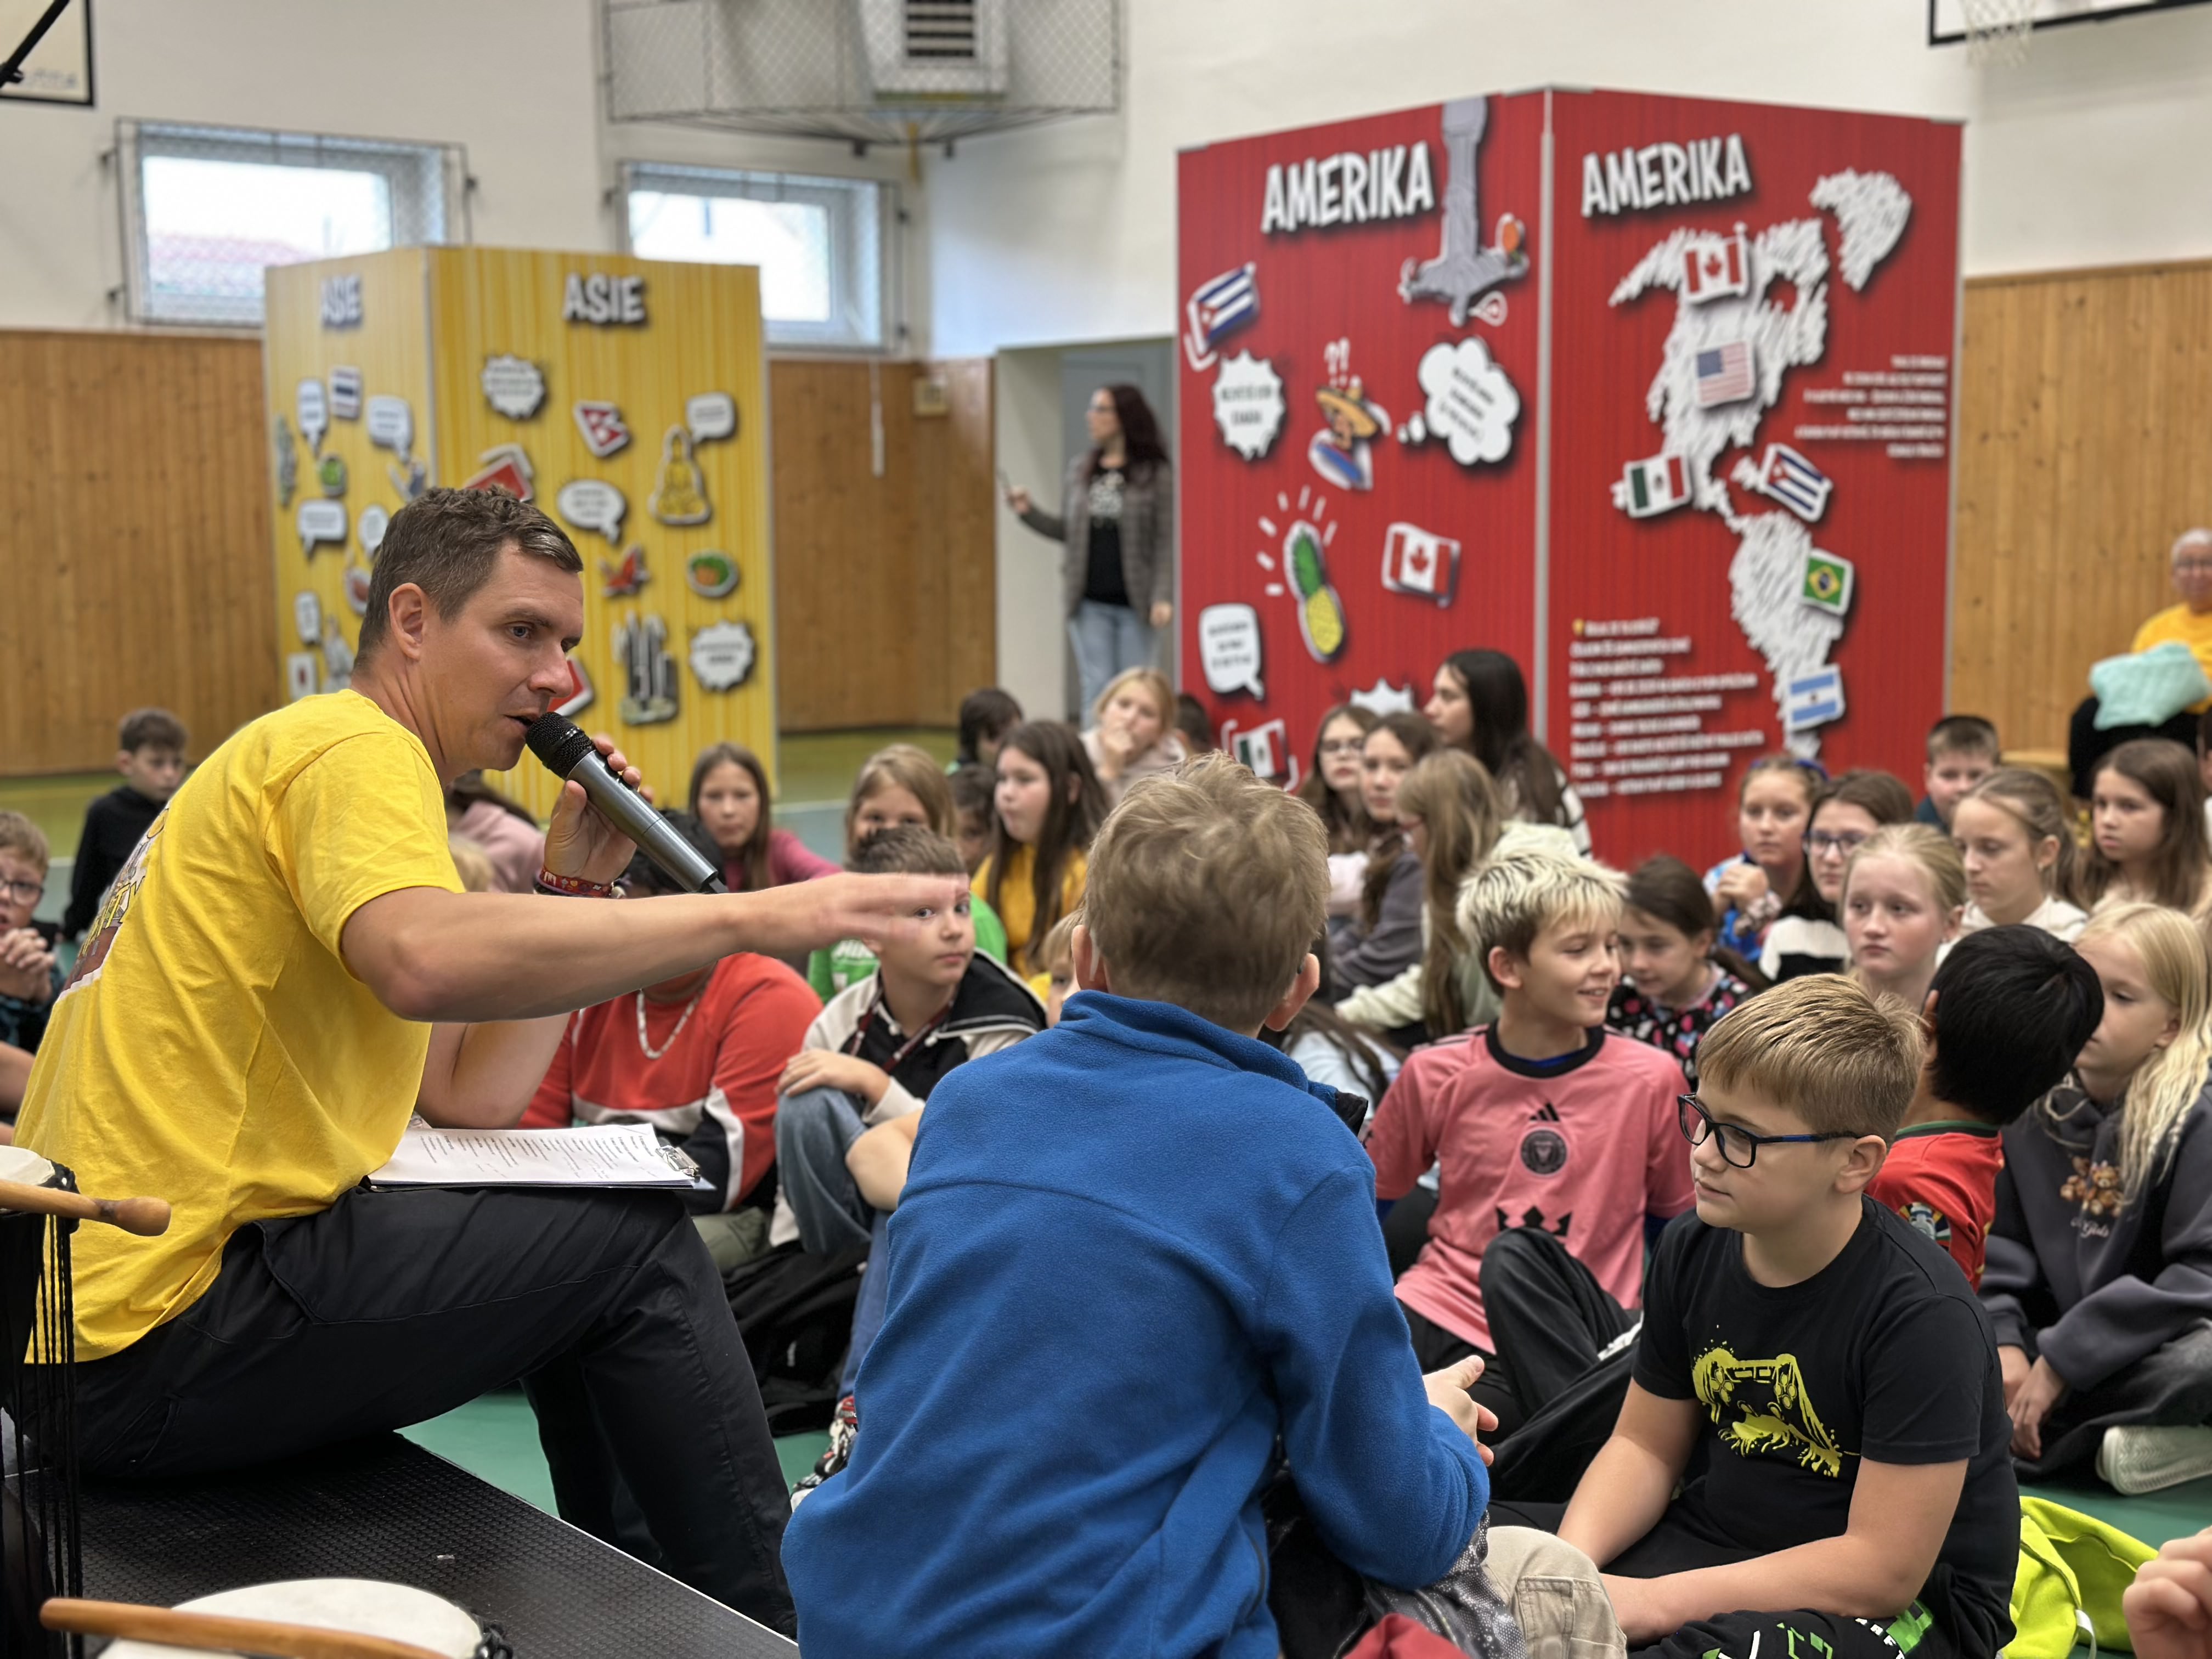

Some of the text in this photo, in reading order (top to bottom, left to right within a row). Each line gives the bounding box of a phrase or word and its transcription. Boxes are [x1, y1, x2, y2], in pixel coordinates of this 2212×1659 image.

[1260, 139, 1435, 234] AMERIKA
[1582, 133, 1752, 218] AMERIKA
[562, 273, 645, 324] ASIE
